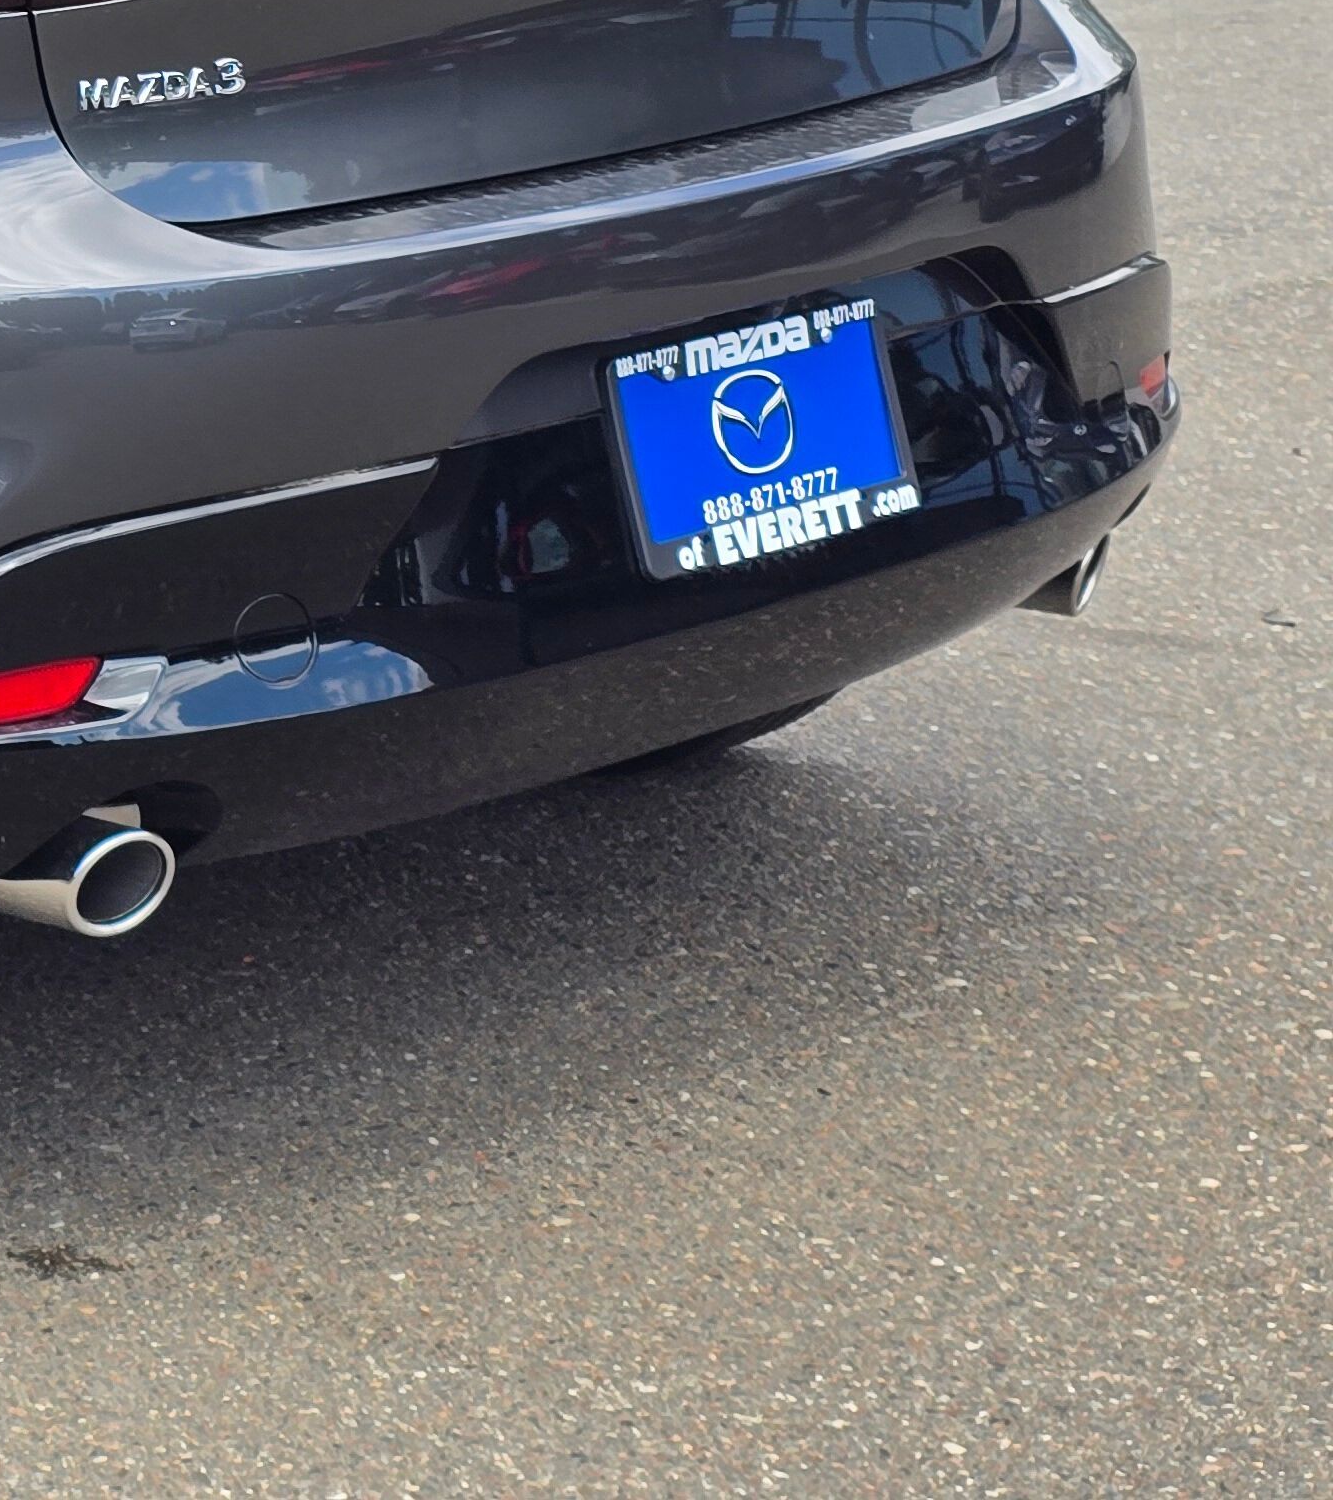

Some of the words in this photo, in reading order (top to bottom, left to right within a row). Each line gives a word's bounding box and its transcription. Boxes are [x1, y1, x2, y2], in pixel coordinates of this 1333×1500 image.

[678, 536, 704, 571] of
[711, 488, 864, 566] EVERETT
[872, 484, 920, 518] .com
[702, 466, 838, 525] 888-871-8777
